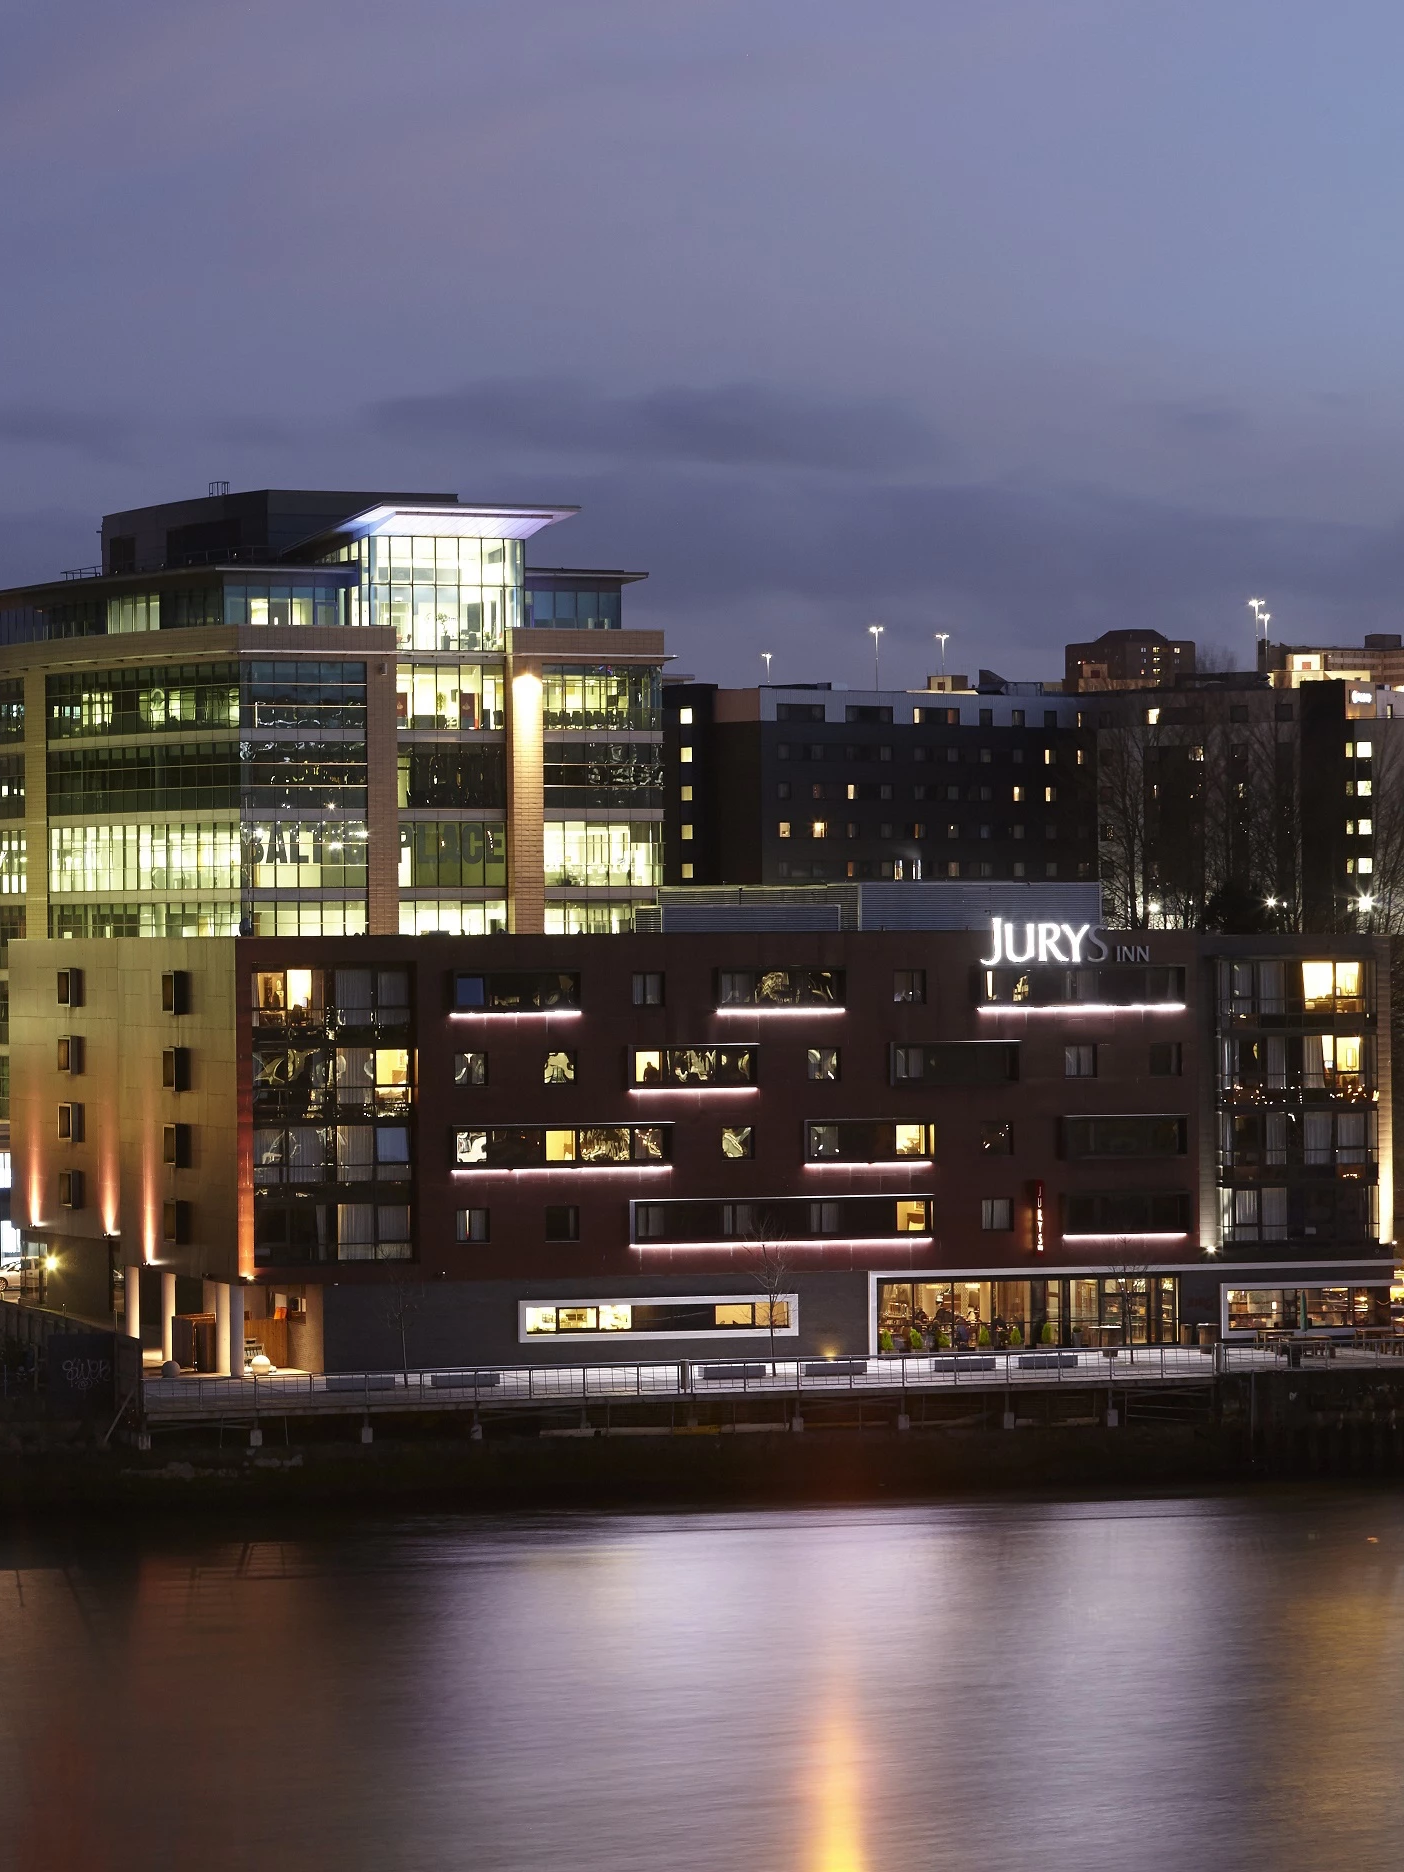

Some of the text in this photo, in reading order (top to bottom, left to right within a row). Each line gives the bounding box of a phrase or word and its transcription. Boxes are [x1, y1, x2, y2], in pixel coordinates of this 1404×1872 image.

[397, 823, 504, 864] PLACE
[980, 917, 1150, 966] JURYS INN
[1036, 1186, 1044, 1245] JURYS
